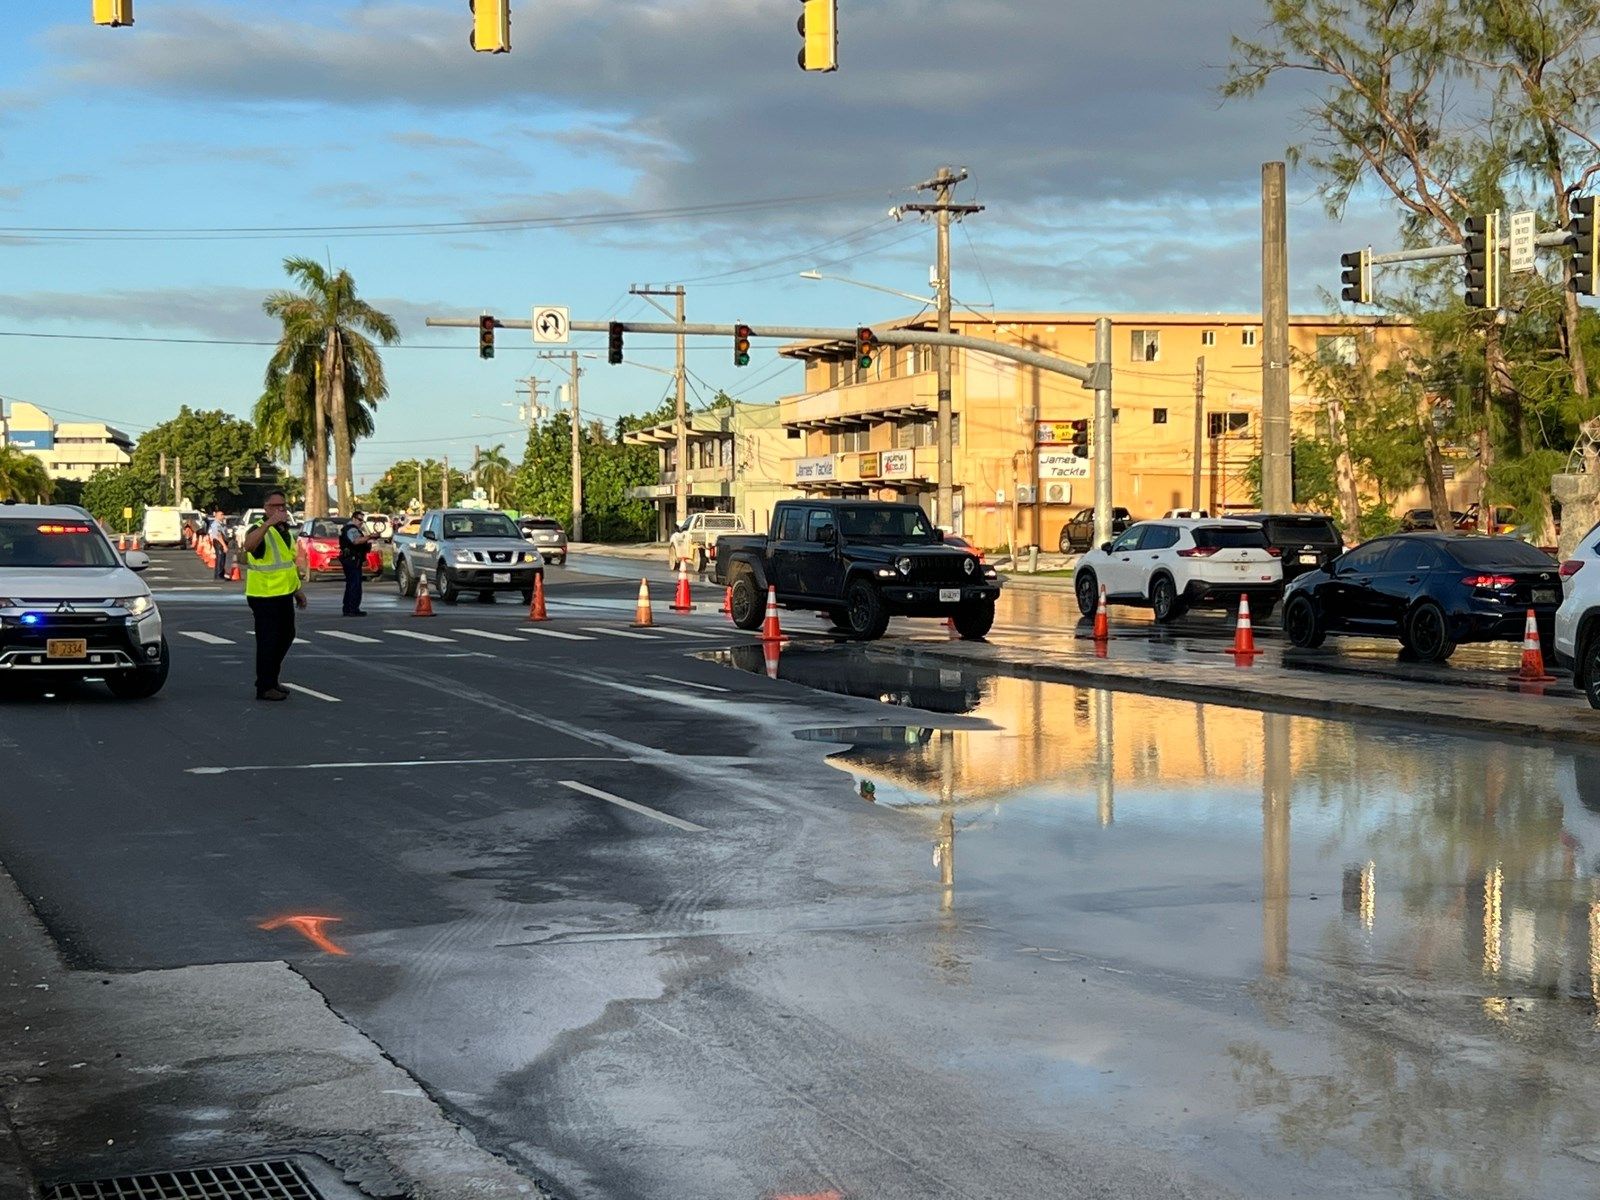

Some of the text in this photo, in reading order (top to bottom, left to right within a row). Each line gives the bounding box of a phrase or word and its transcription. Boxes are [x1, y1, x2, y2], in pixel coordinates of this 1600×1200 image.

[1040, 456, 1077, 464] James
[815, 462, 832, 476] Tackle
[1050, 467, 1087, 476] Tackle
